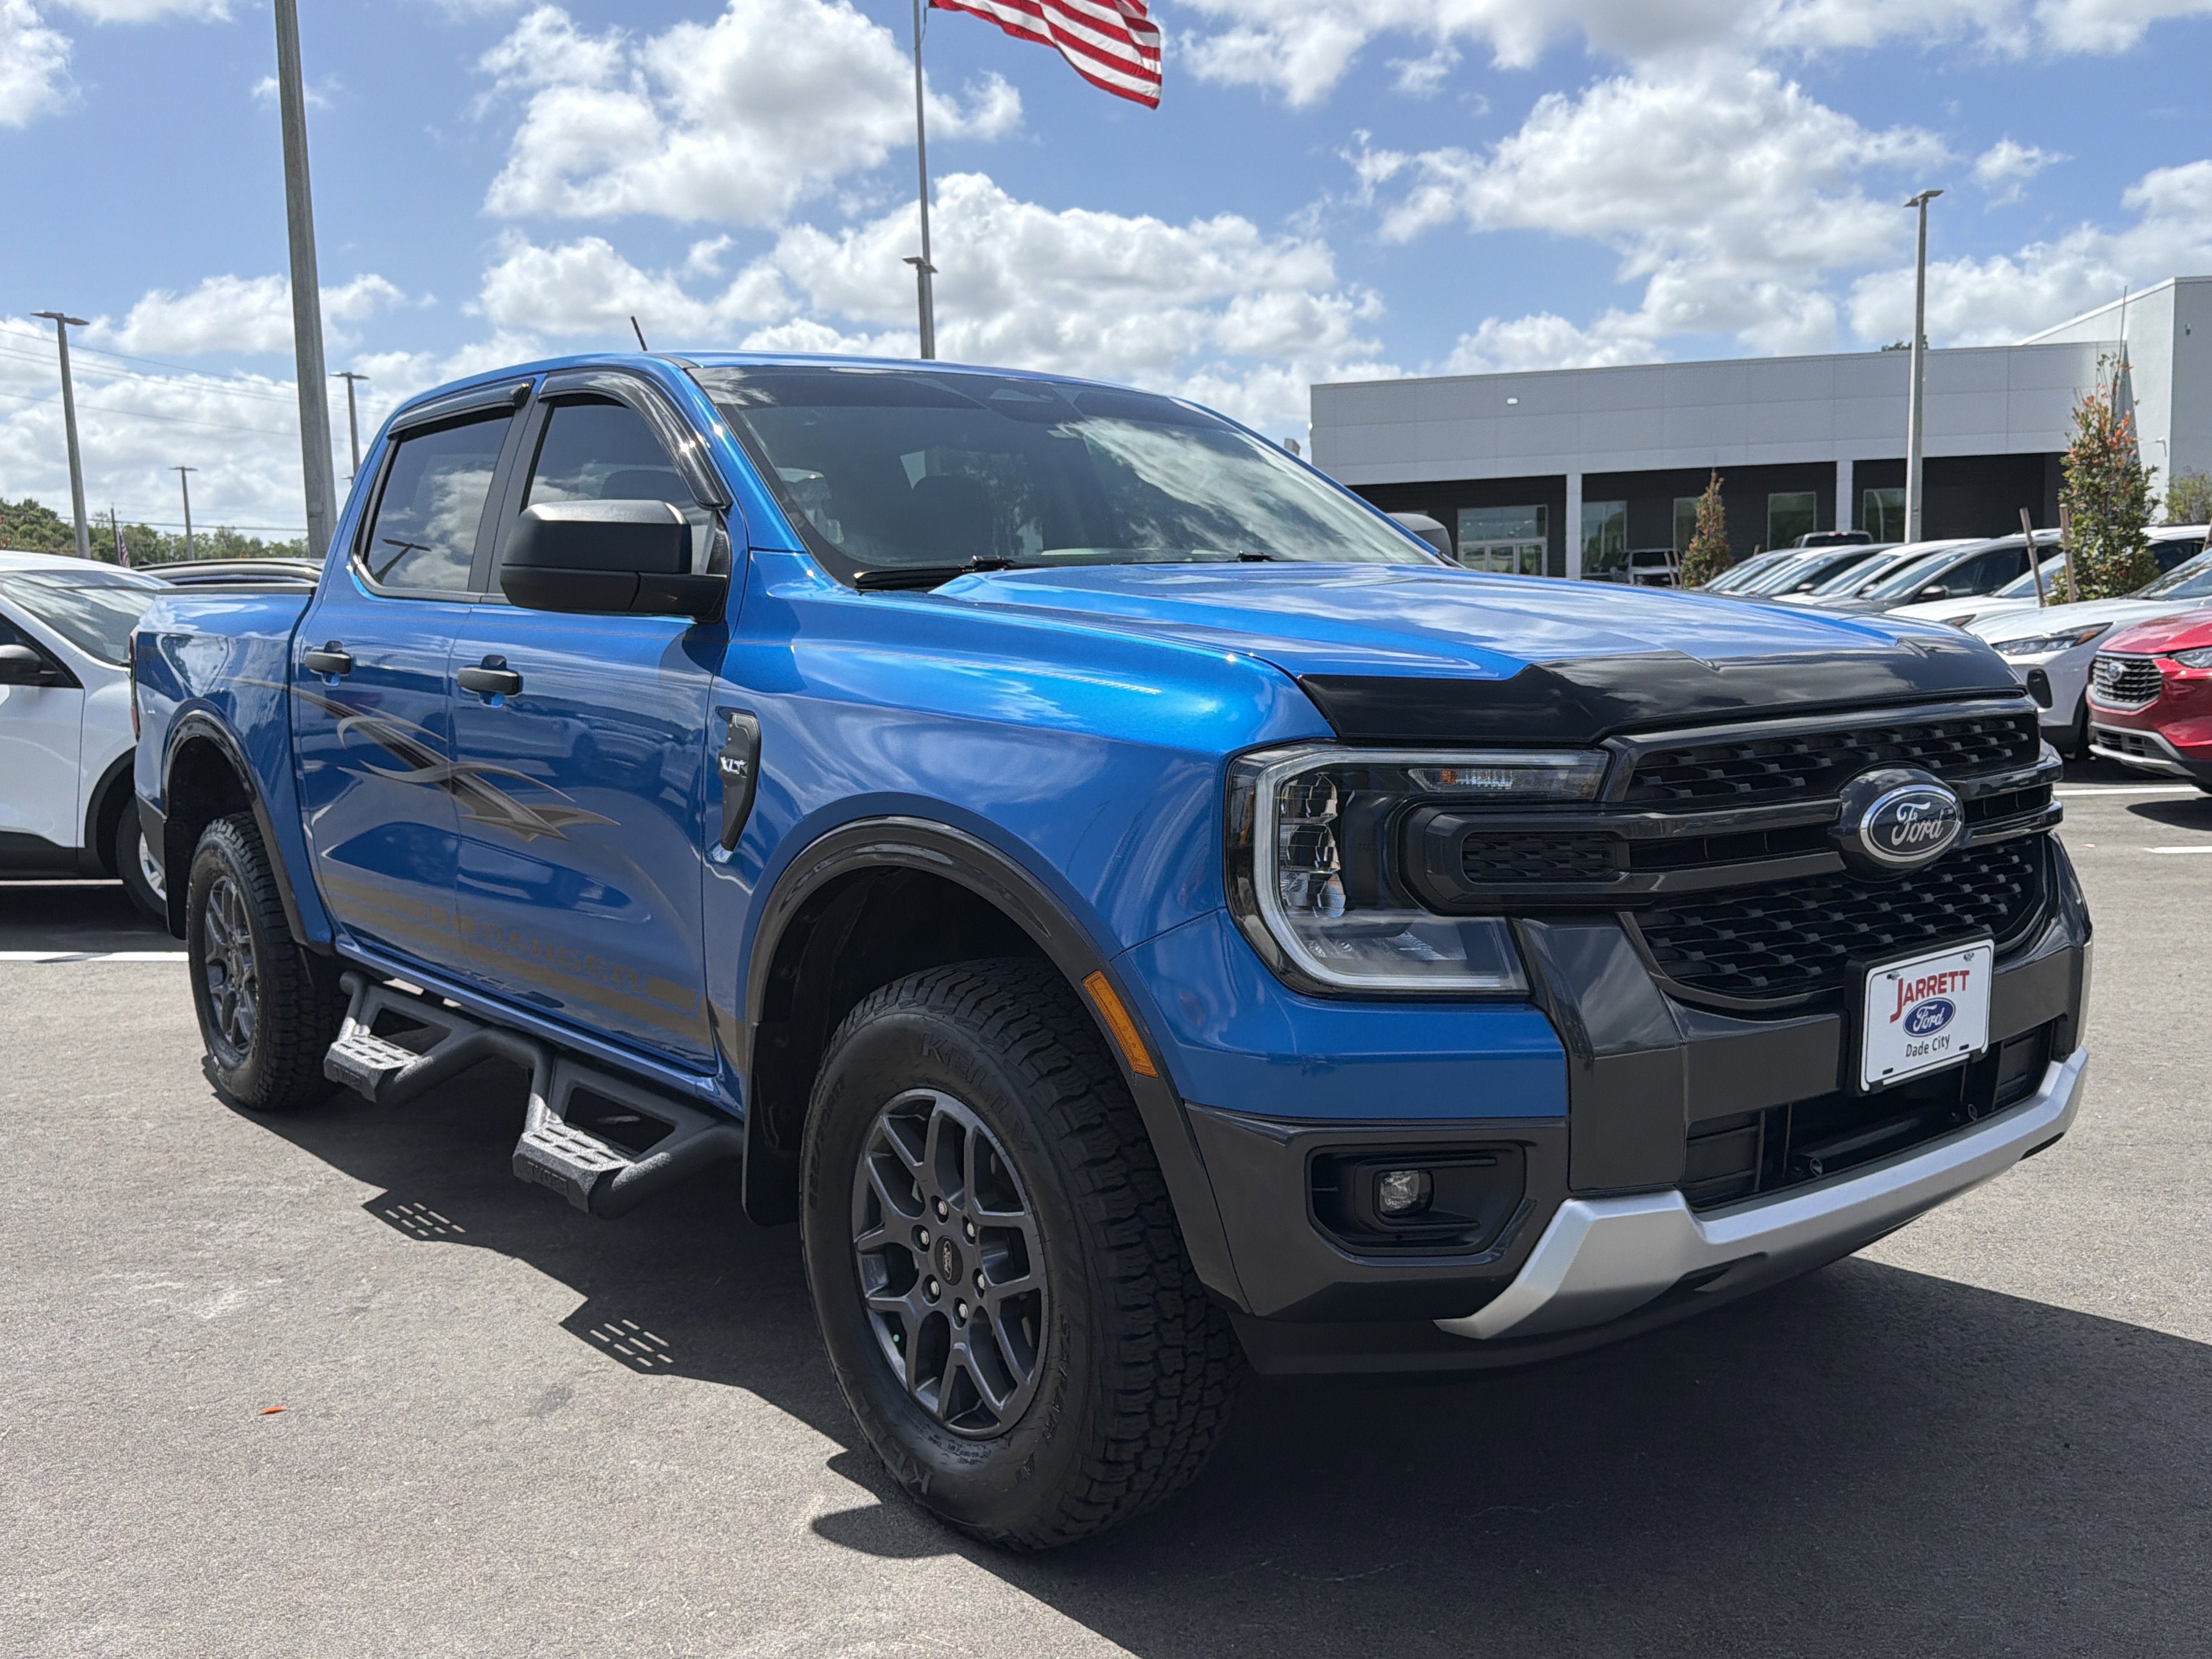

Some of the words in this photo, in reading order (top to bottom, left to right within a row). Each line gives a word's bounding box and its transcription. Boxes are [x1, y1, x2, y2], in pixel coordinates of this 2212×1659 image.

[1891, 802, 1943, 846] Ford
[482, 922, 641, 992] RANGER
[1889, 970, 1970, 1023] JARRETT
[1913, 1004, 1945, 1032] Ford
[1906, 1041, 1929, 1057] Dade
[1932, 1034, 1950, 1051] City
